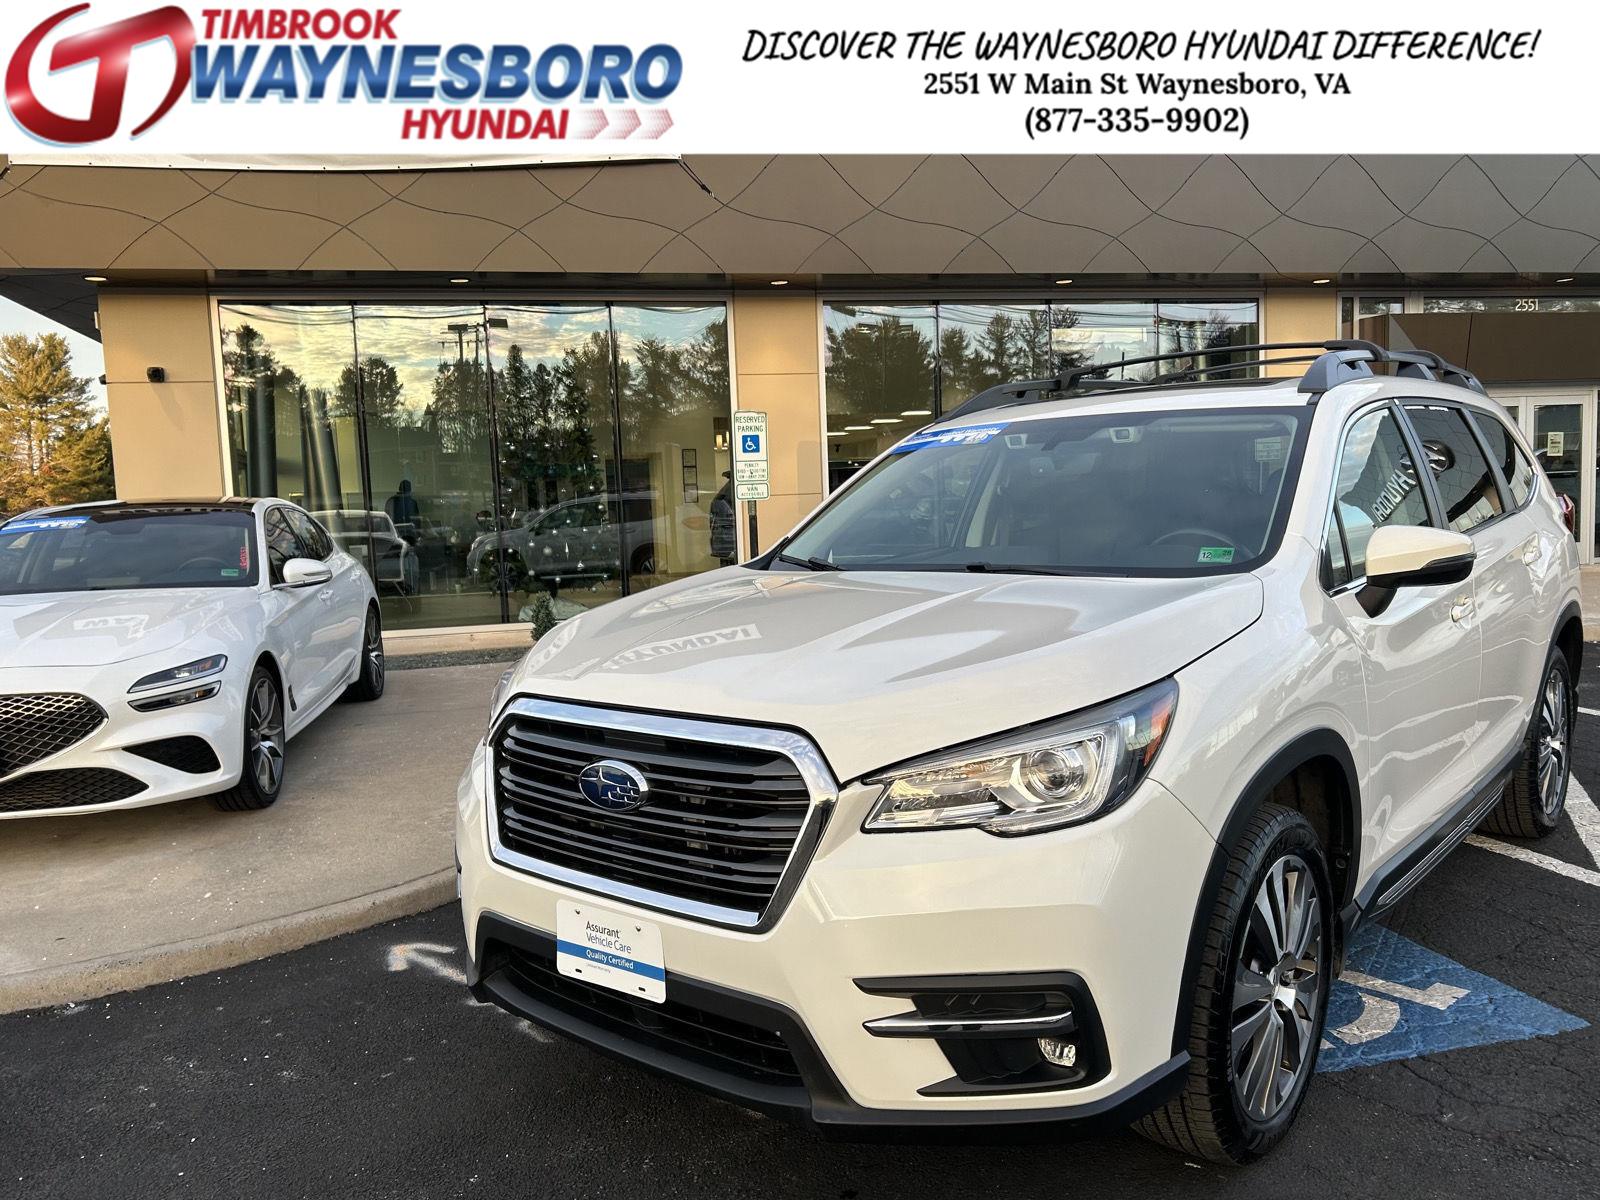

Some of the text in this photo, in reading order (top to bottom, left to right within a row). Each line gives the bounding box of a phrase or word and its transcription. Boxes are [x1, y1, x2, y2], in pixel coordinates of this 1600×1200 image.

[1515, 299, 1539, 311] 2551
[585, 921, 620, 939] Assurant
[586, 932, 632, 954] Vehicle Care
[586, 949, 608, 963] Quality
[608, 955, 634, 969] Certified
